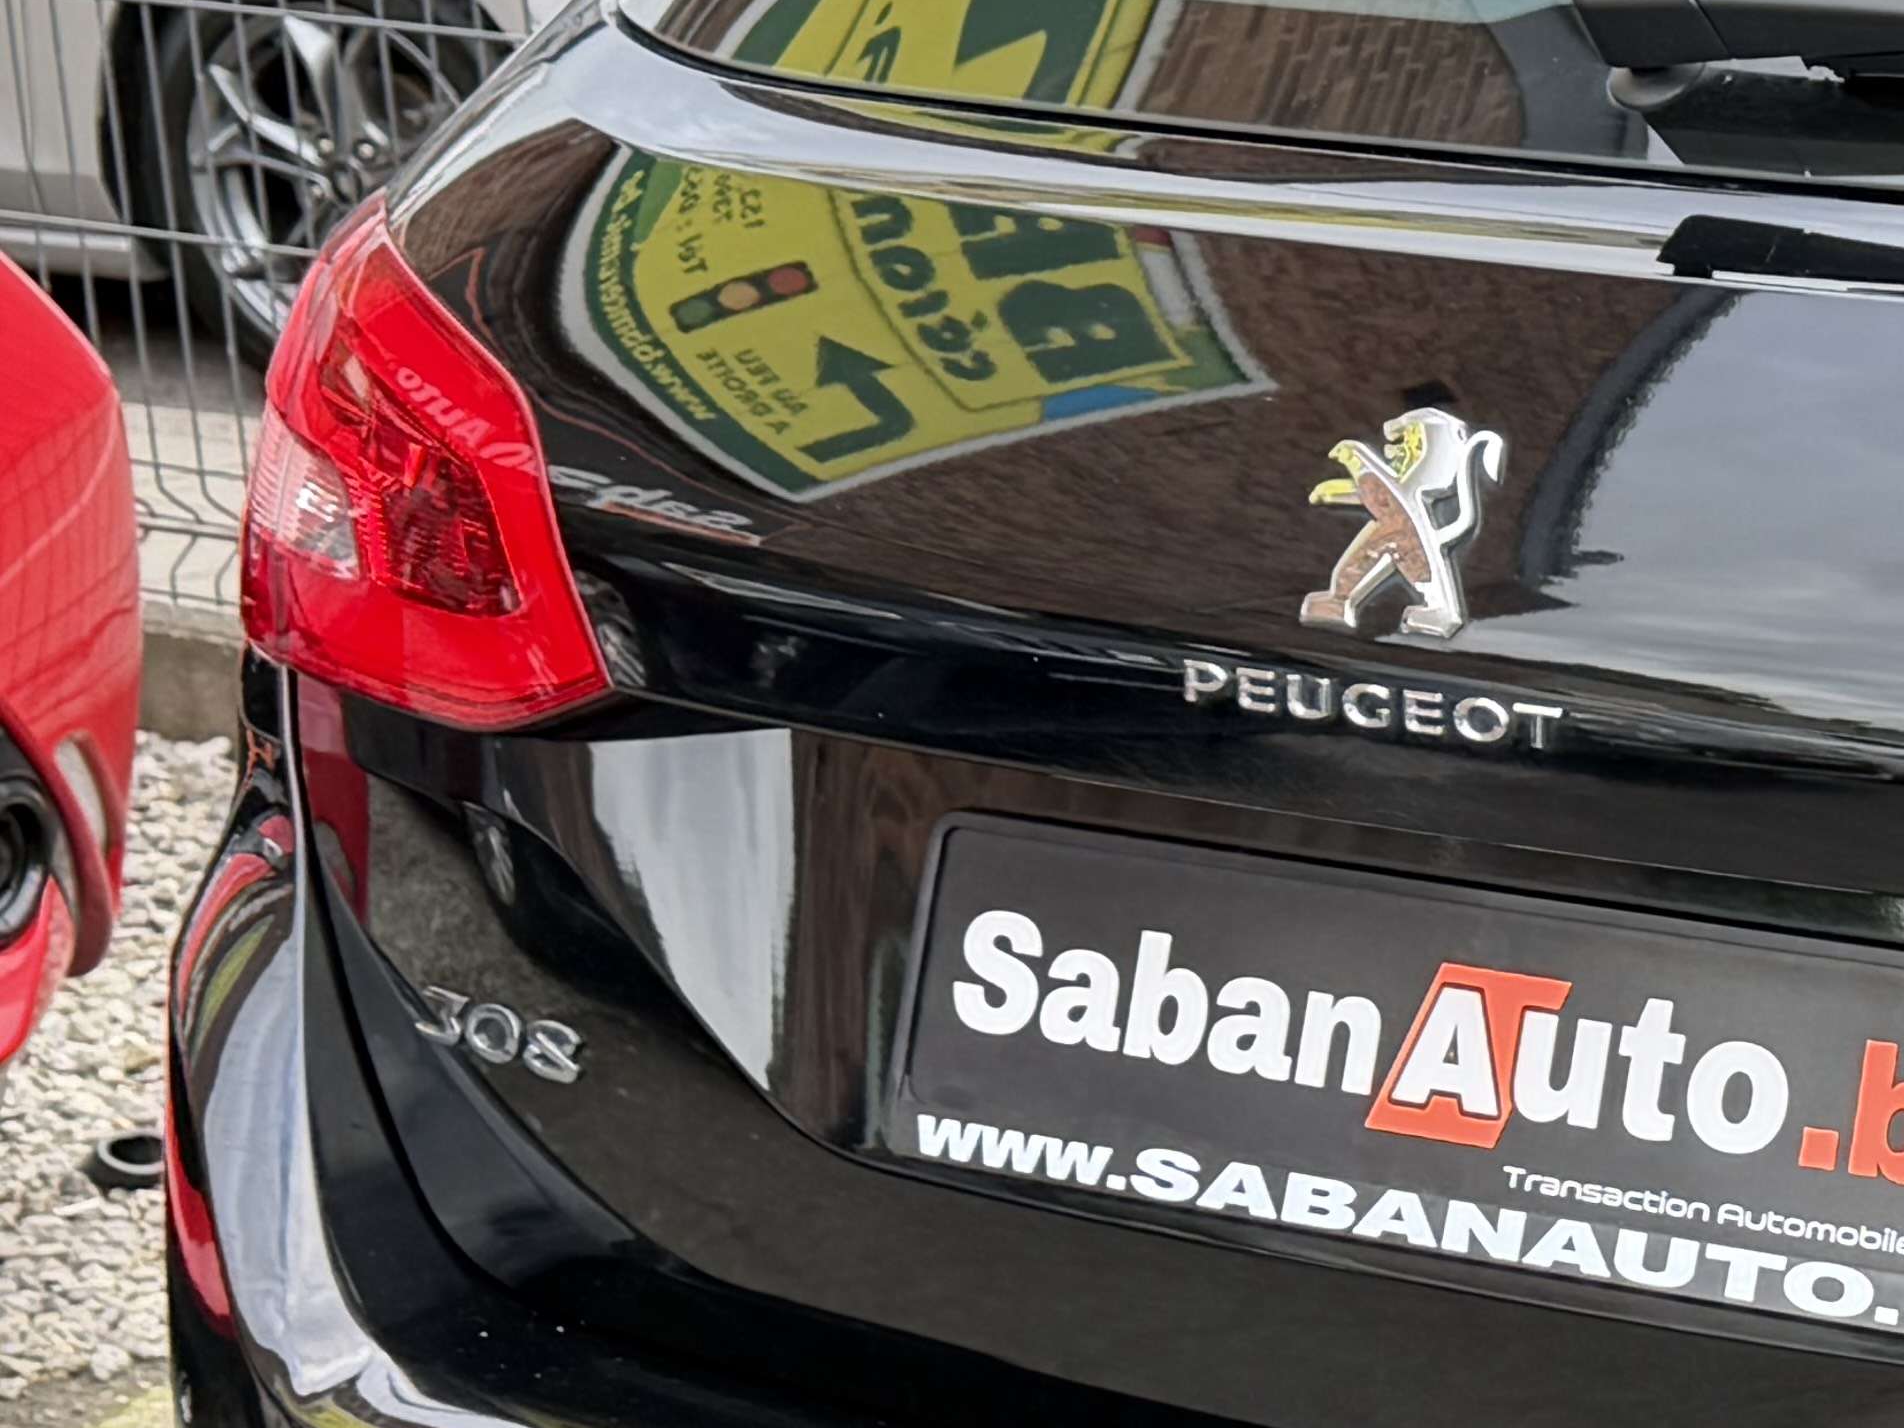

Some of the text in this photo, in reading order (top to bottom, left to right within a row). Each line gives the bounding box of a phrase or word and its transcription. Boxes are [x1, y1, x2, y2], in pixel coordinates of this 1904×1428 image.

[1183, 658, 1564, 750] PEUGEOT
[413, 984, 584, 1085] 308
[1502, 1164, 1711, 1224] Transaction
